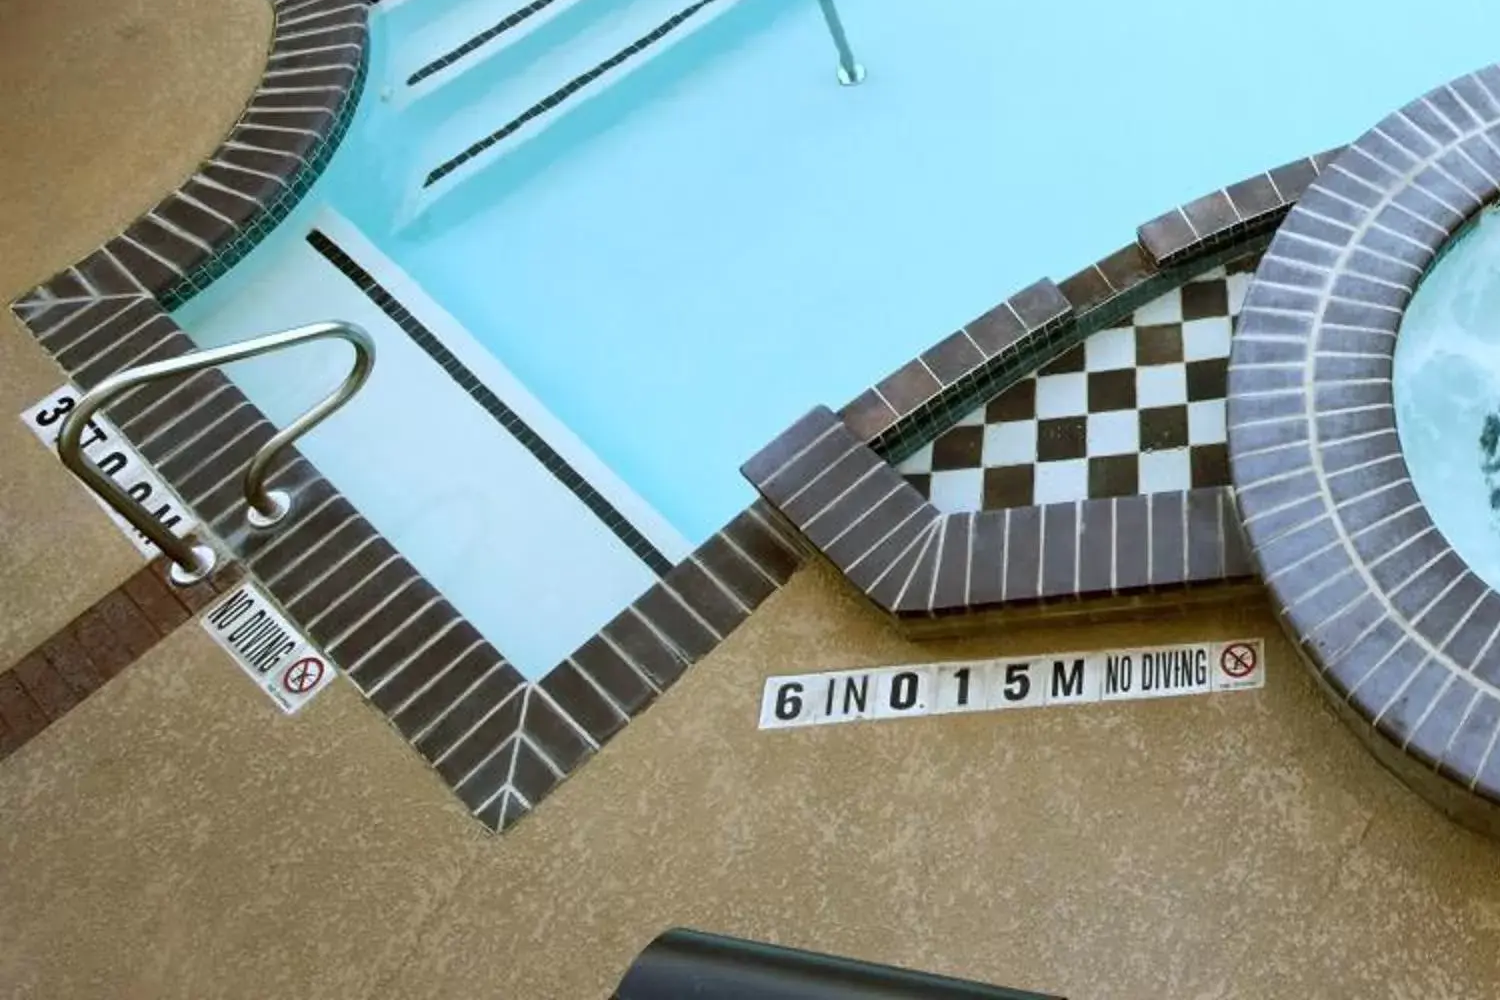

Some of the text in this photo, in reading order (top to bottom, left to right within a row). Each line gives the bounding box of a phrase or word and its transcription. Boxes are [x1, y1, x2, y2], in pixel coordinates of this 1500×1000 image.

[35, 396, 76, 427] 3
[207, 588, 255, 631] NO
[227, 609, 297, 674] DIVING
[775, 681, 804, 721] 6
[825, 674, 869, 717] IN
[1051, 659, 1086, 698] M
[1105, 656, 1132, 694] NO
[1141, 648, 1207, 688] DIVING
